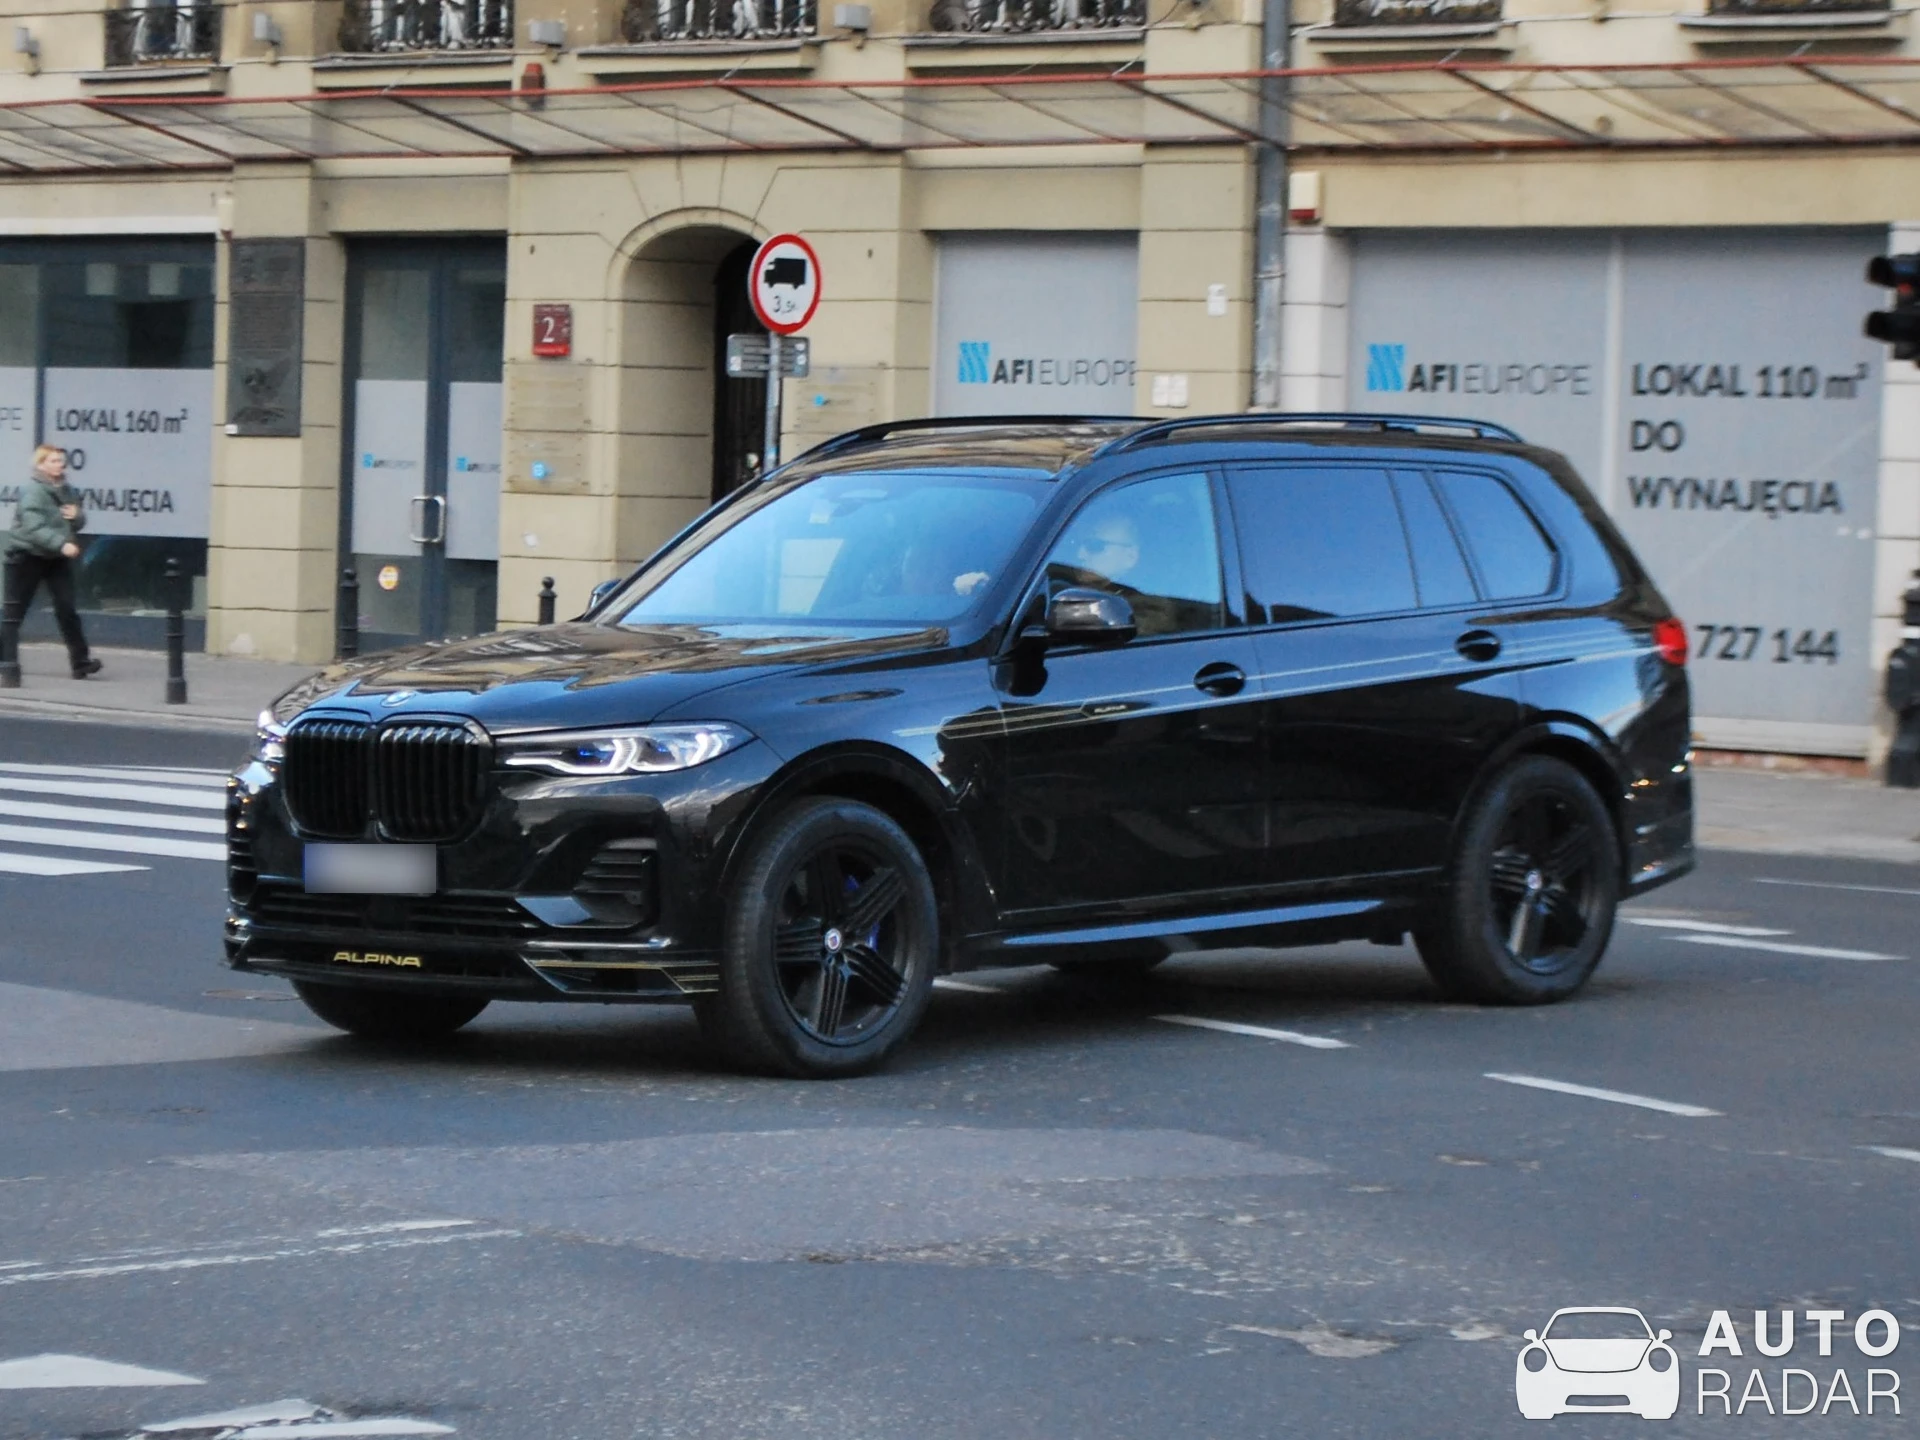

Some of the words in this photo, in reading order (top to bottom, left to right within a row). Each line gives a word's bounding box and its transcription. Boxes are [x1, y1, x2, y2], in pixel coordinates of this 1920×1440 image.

[541, 317, 555, 343] 2
[992, 359, 1033, 384] AFI
[1408, 363, 1458, 392] AFI
[1464, 363, 1590, 395] EUROPE
[1632, 363, 1746, 397] LOKAL
[1756, 365, 1817, 398] 110
[56, 408, 119, 432] LOKAL
[125, 410, 157, 433] 160
[1630, 419, 1683, 452] DO
[77, 487, 174, 517] YNAJĘCIA
[1629, 475, 1842, 519] WYNAJĘCIA
[1695, 623, 1761, 661] 727
[1770, 628, 1839, 665] 144
[333, 951, 422, 968] ALPINA
